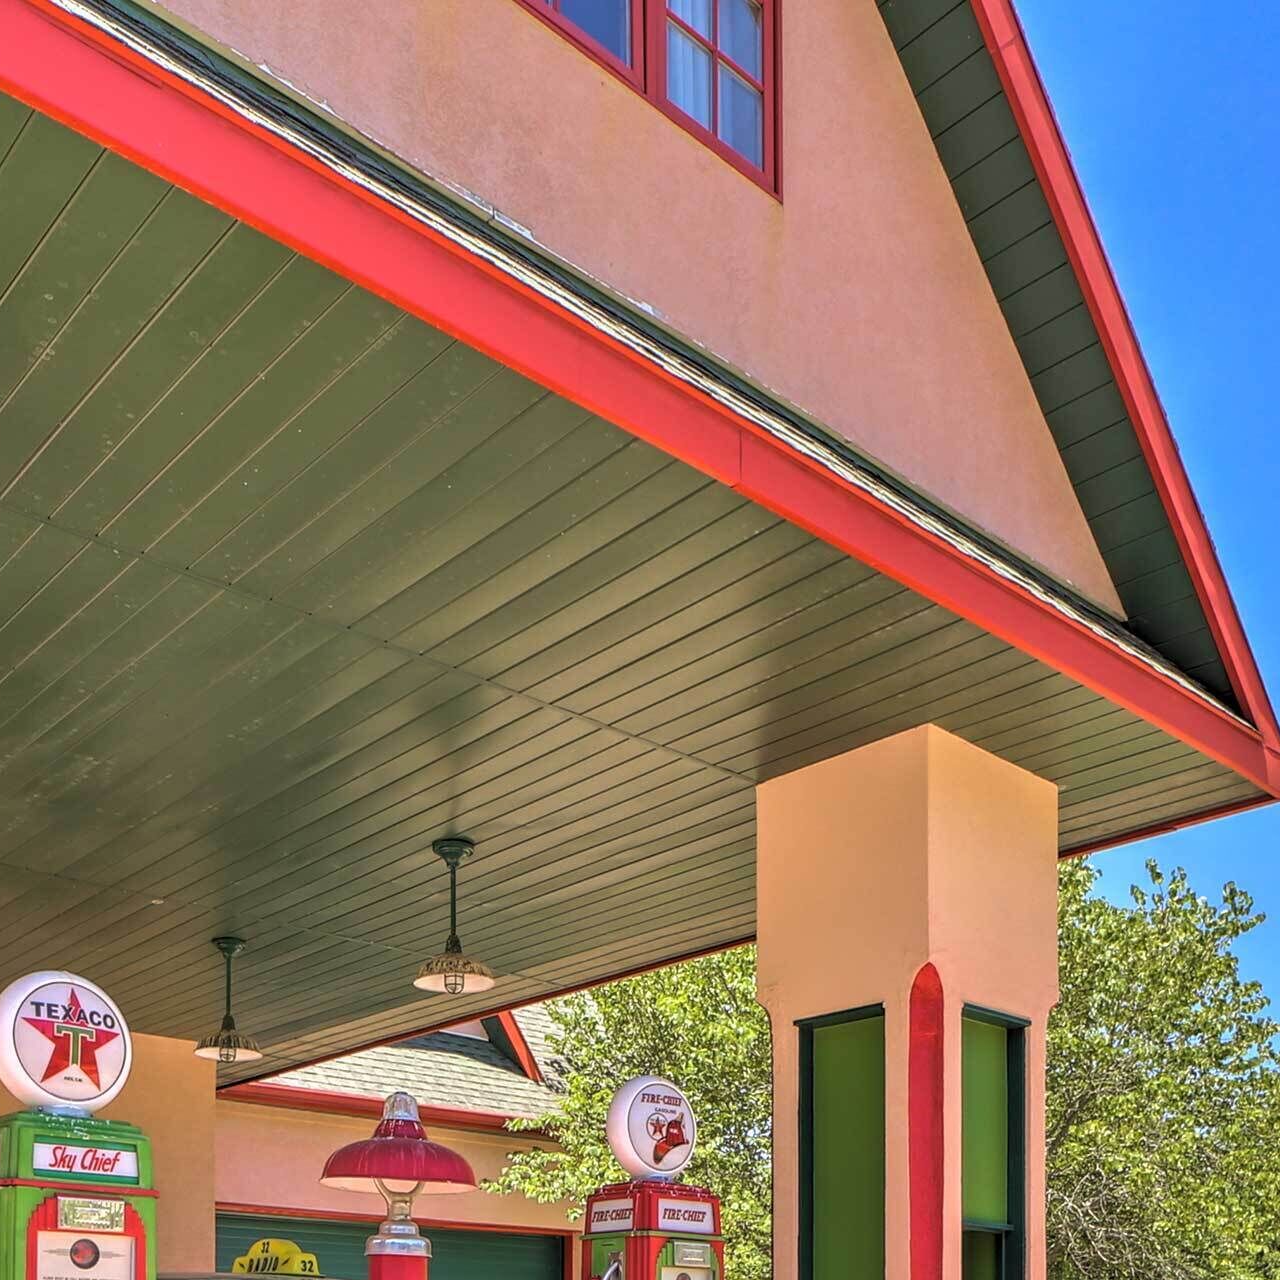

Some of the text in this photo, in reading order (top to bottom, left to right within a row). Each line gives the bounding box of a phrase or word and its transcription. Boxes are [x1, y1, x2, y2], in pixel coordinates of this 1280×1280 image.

[30, 1001, 116, 1030] TEXACO
[641, 1093, 682, 1107] FIRE-CHIEF
[49, 1146, 121, 1172] Sky Chief
[592, 1208, 634, 1223] FIRE-CHIEF
[663, 1208, 707, 1223] FIRE-CHIEF
[300, 1260, 314, 1273] 32
